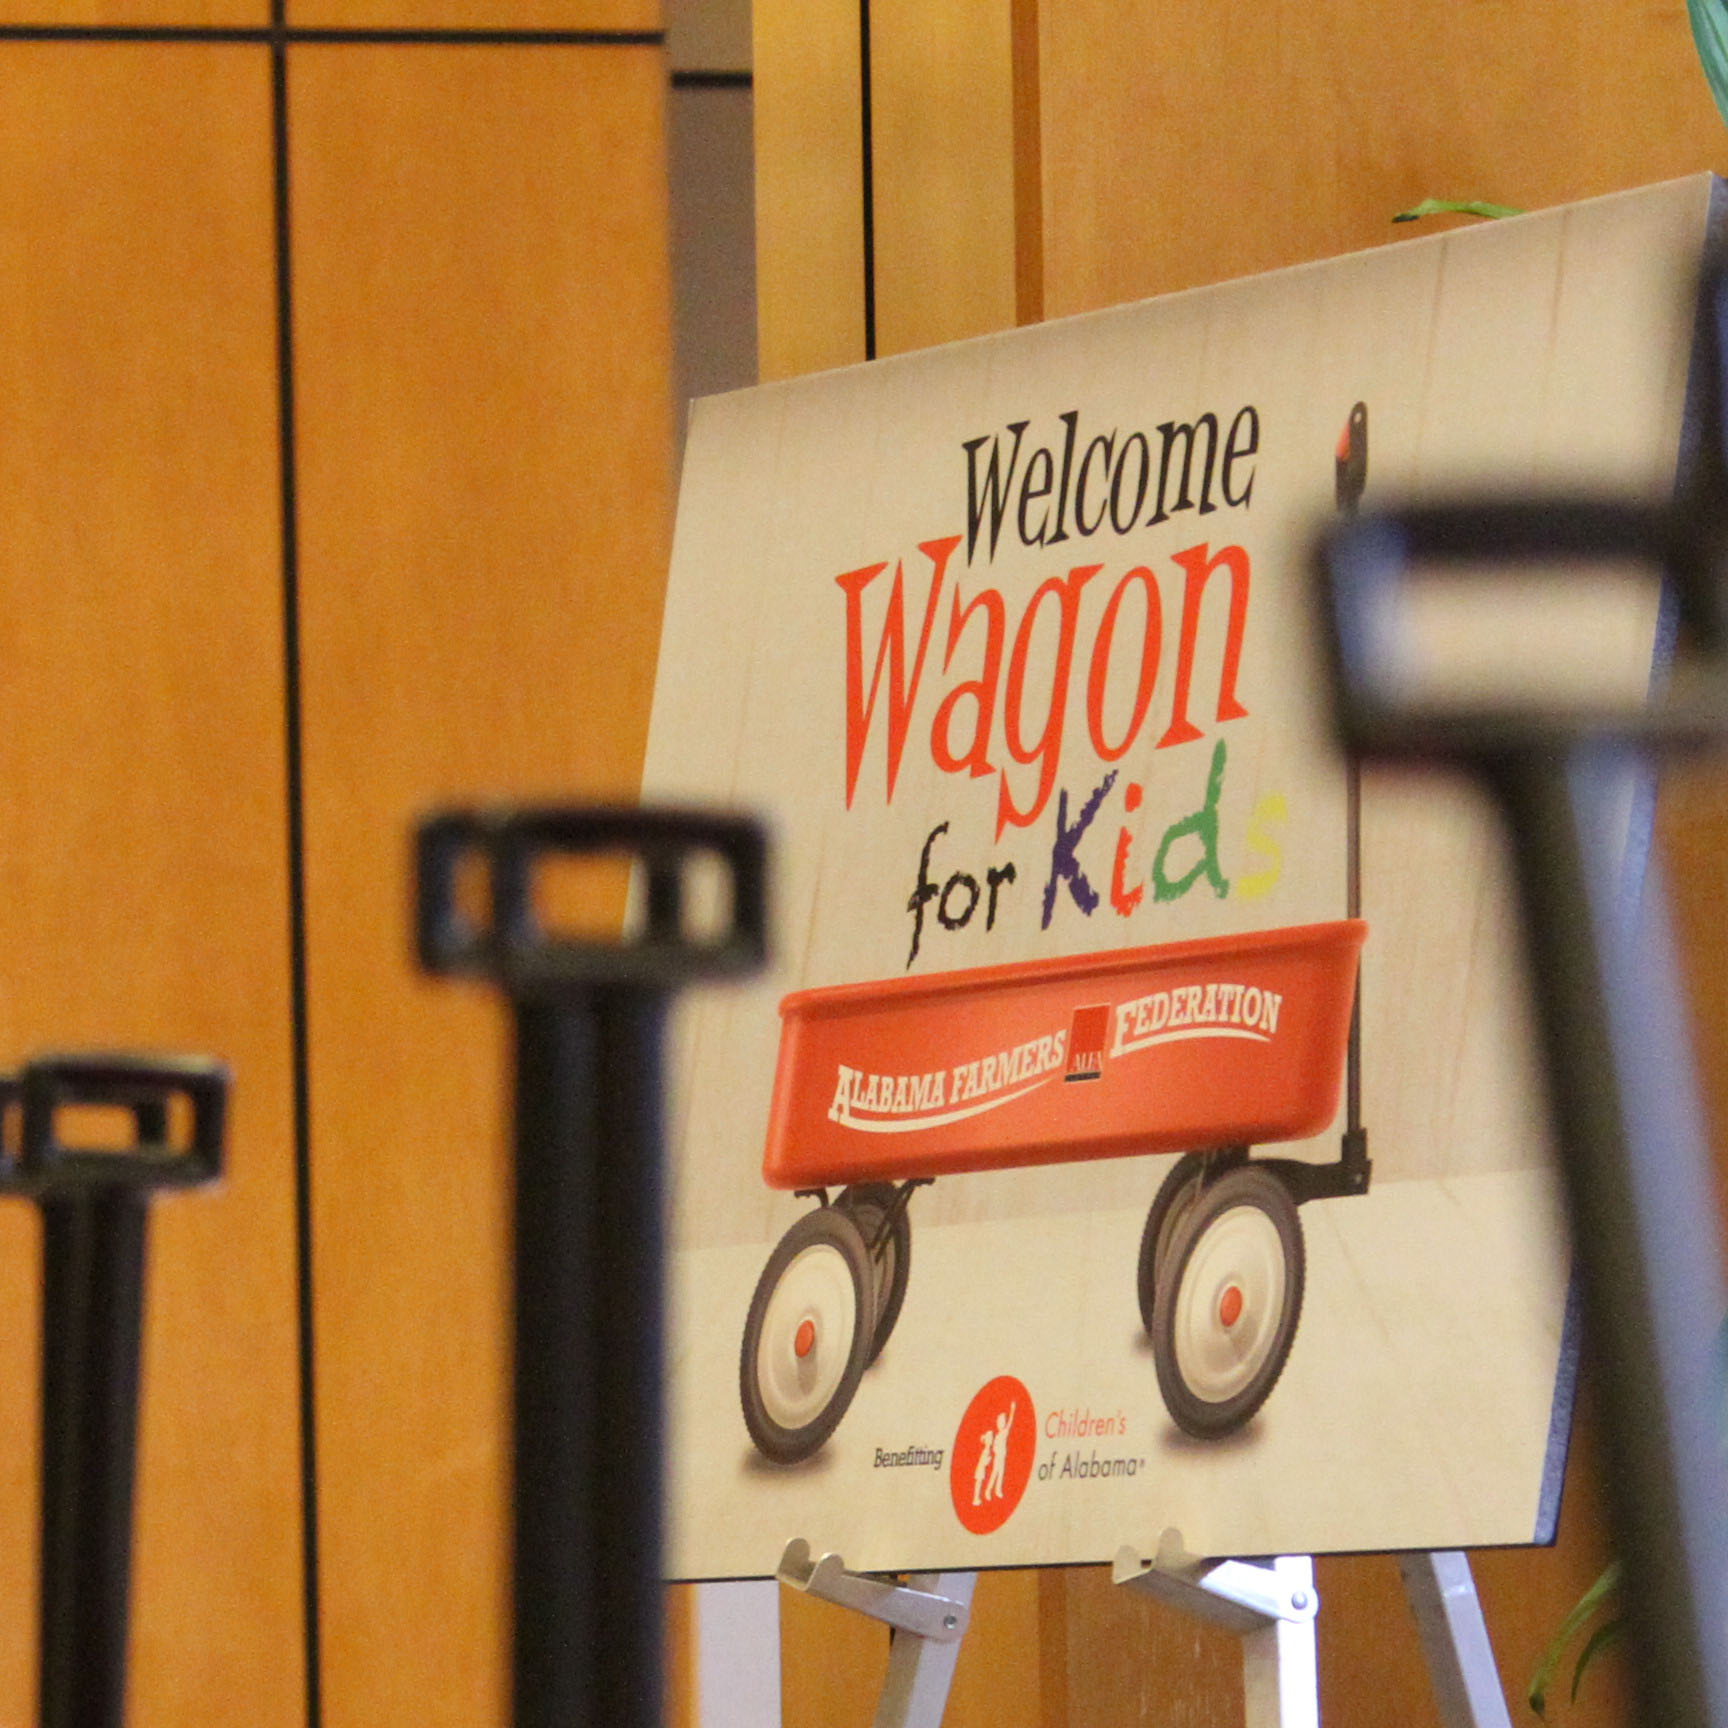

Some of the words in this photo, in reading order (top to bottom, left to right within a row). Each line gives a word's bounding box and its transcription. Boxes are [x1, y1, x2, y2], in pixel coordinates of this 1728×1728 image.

[962, 404, 1261, 569] Welcome
[834, 534, 1251, 845] Wagon
[906, 821, 1017, 971] for
[1041, 738, 1288, 930] Kids
[828, 1064, 946, 1120] ALABAMA
[949, 1029, 1068, 1105] FARMERS
[1110, 983, 1282, 1058] FEDERATION
[1038, 1451, 1059, 1481] of
[1044, 1408, 1127, 1439] Children's
